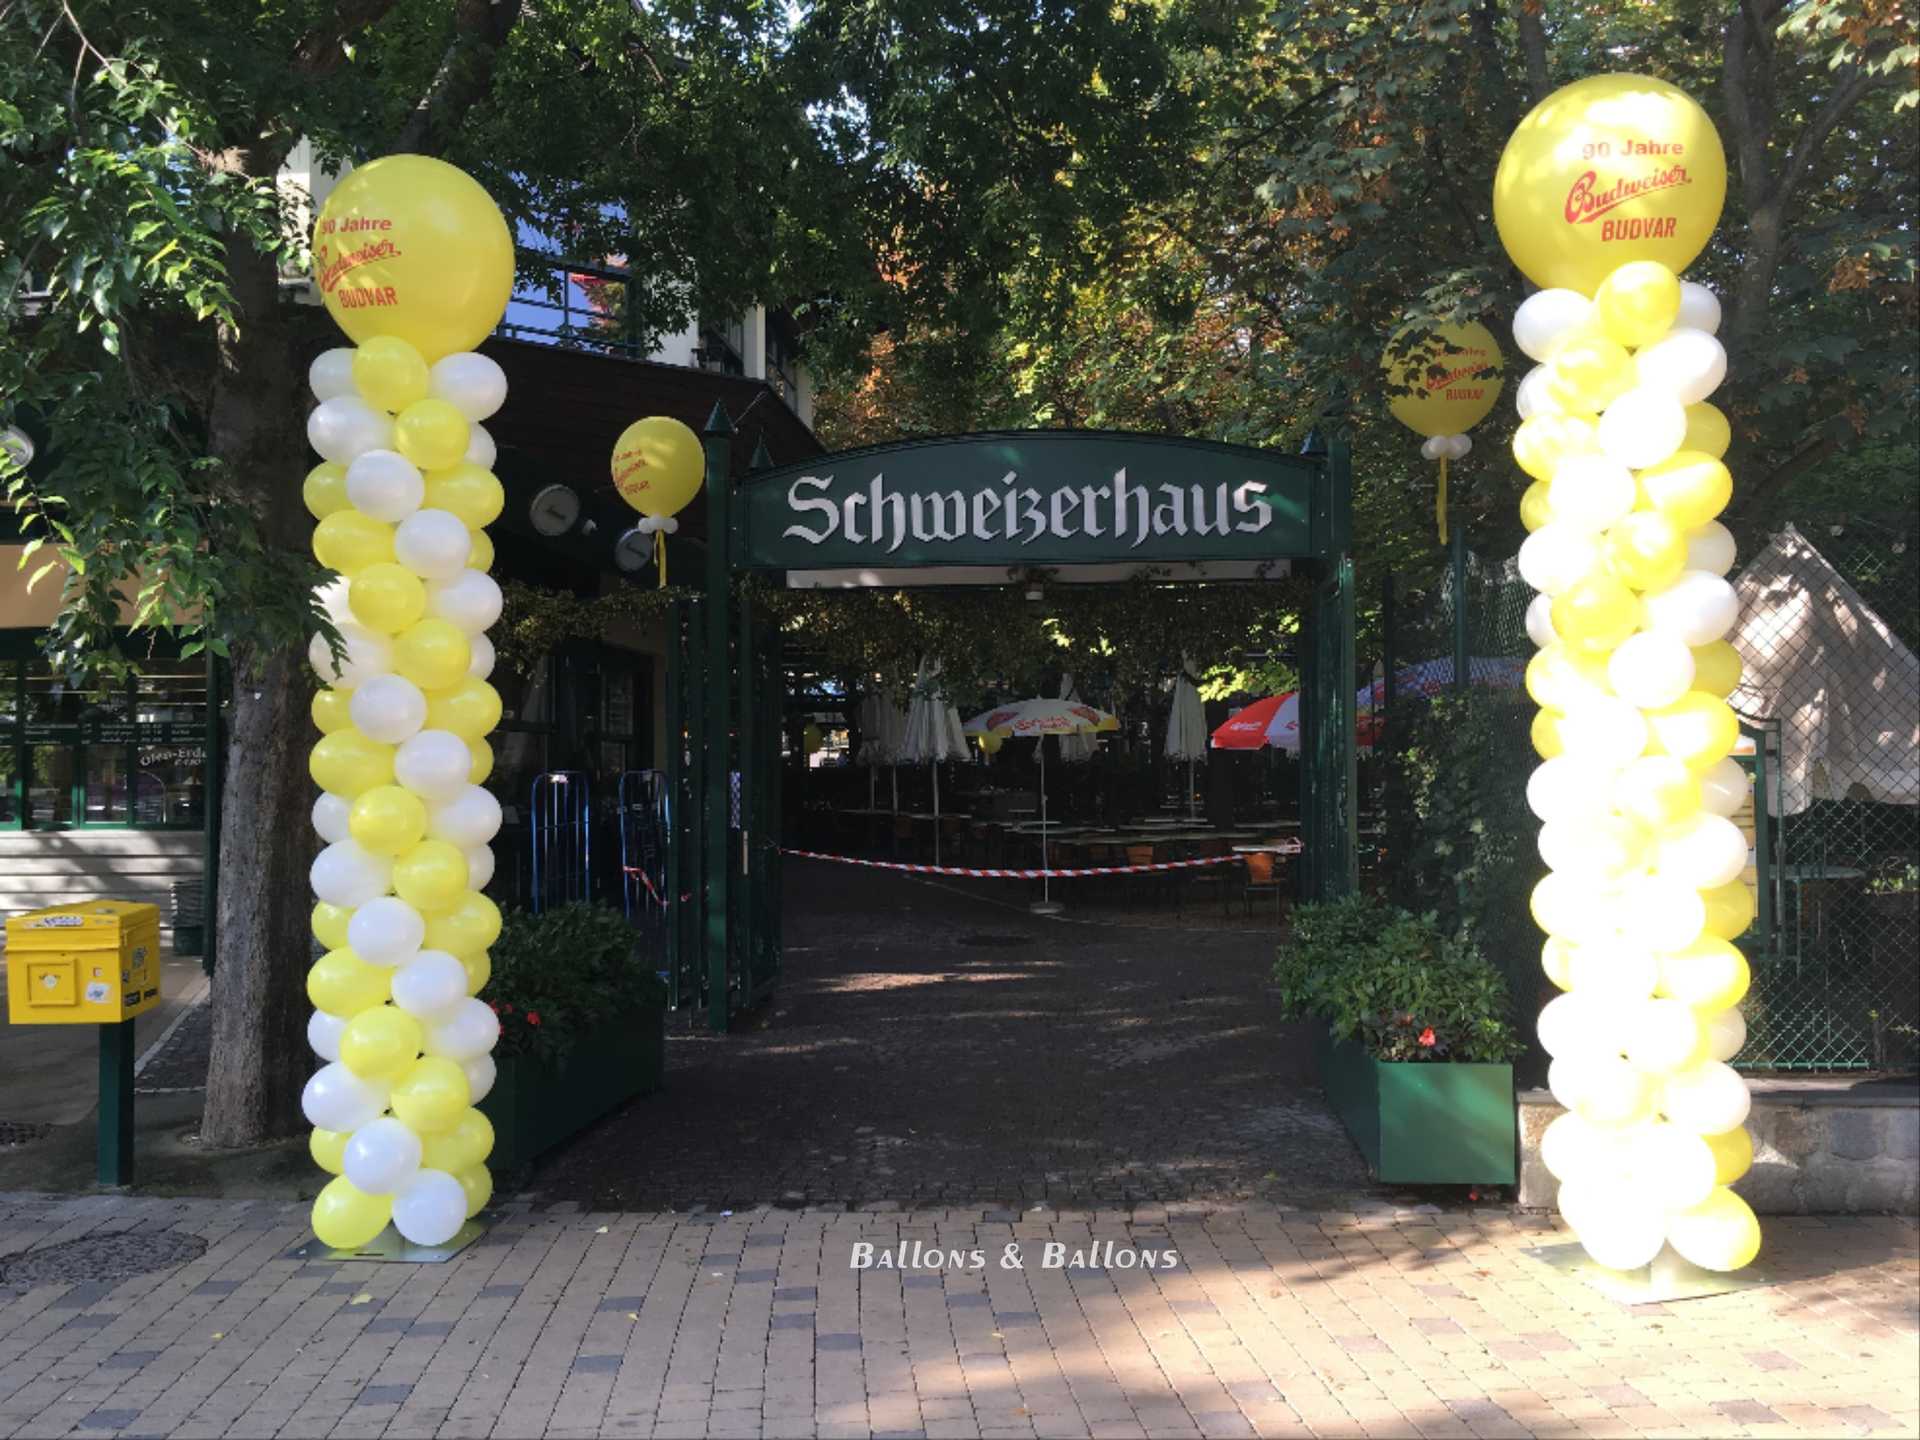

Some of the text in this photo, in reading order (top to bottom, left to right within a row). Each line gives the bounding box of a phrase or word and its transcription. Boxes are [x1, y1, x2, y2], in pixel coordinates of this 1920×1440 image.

[1582, 139, 1685, 160] 90 Jahre
[1565, 165, 1693, 224] Budweiser
[340, 216, 392, 232] Jahre
[1601, 216, 1677, 241] BUDVAR
[782, 467, 1273, 553] Schweizerhaus
